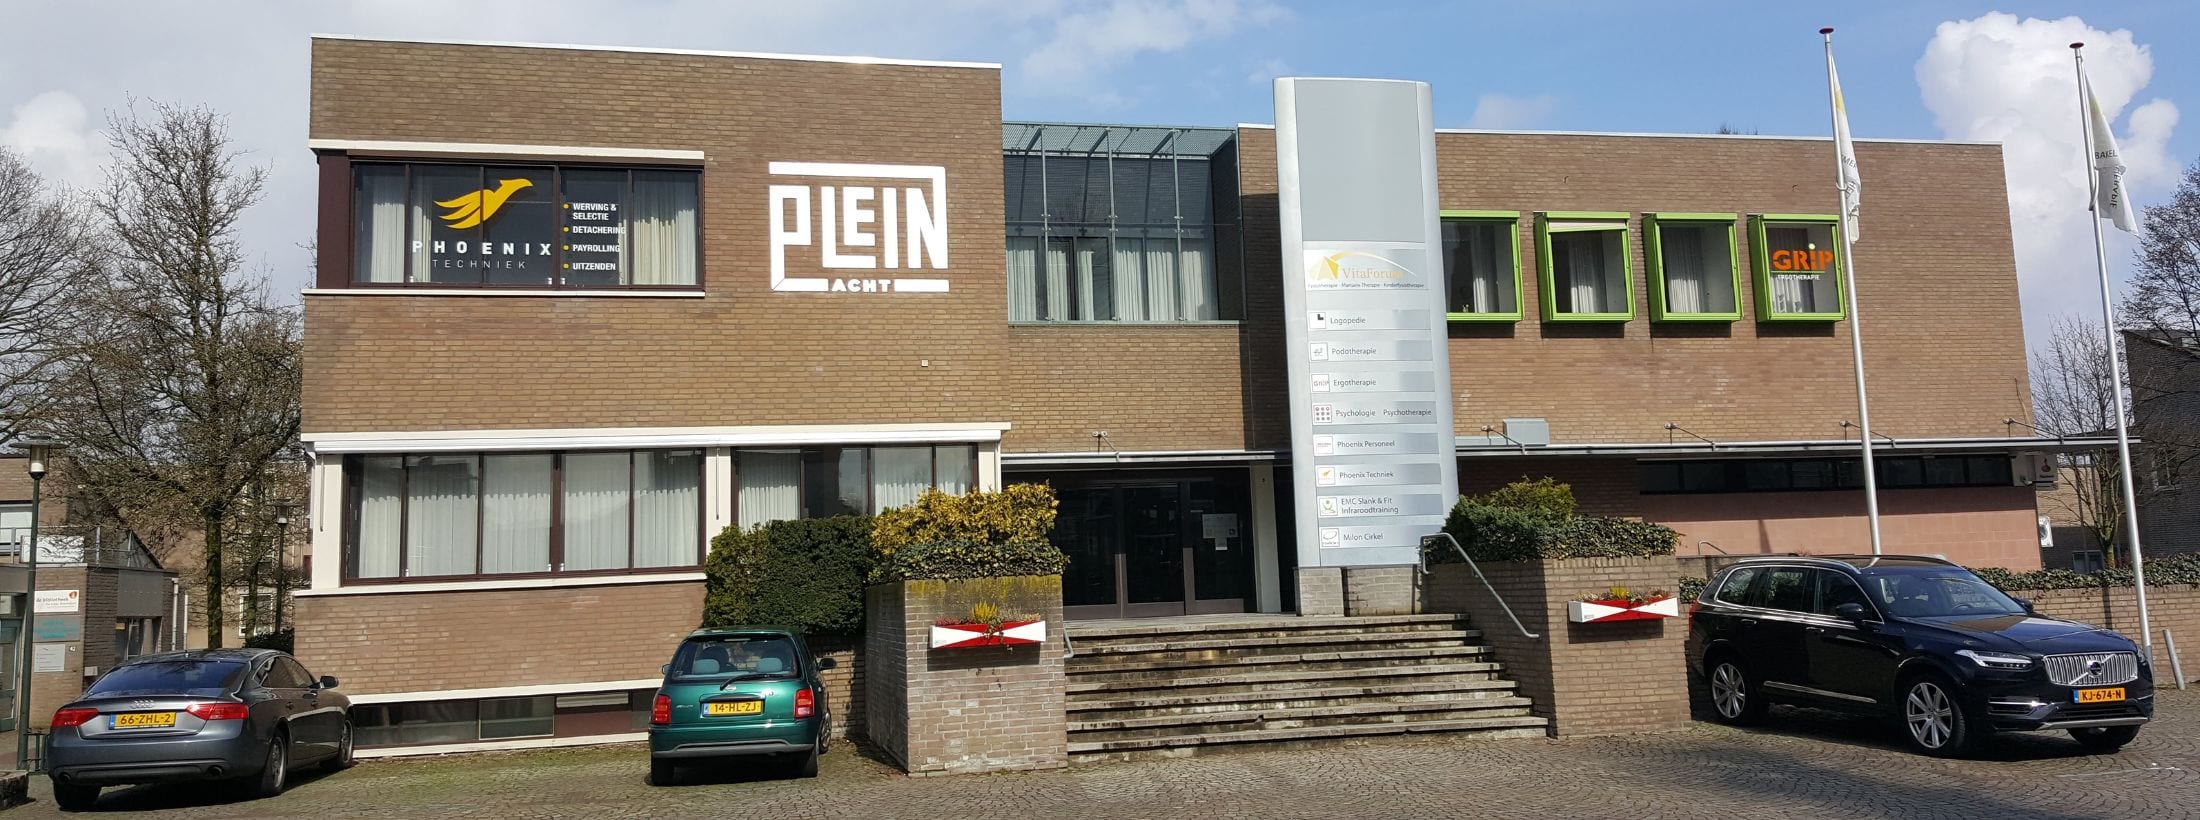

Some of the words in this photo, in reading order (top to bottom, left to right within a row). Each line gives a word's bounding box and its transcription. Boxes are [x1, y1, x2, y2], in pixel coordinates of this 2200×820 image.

[573, 203, 608, 212] WERVING
[610, 203, 617, 212] &
[573, 212, 609, 221] SELECTIE
[572, 226, 626, 235] DETACHERING
[769, 185, 949, 270] PLEIN
[412, 240, 552, 256] PHOENIX
[572, 244, 621, 253] PAYROLLING
[432, 259, 527, 270] TECHNIEK
[572, 262, 616, 271] UITZENDEN
[831, 278, 892, 293] ACHT
[1330, 317, 1366, 325] Logopedie
[1331, 347, 1377, 356] Podotherapie
[1333, 378, 1377, 388] Ergotherapie
[1336, 409, 1376, 418] Psychologie
[1383, 408, 1432, 417] Psychotherapie
[1364, 440, 1395, 448] Personeel
[1339, 471, 1365, 479] Phoenix
[1341, 506, 1399, 515] Infraroodtraining
[1343, 533, 1363, 541] Milon
[1364, 532, 1384, 540] Cirkel
[2082, 690, 2122, 701] KJ-674-N
[714, 702, 757, 713] 14-HL-ZJ
[120, 712, 172, 726] 66-ZHL-2
